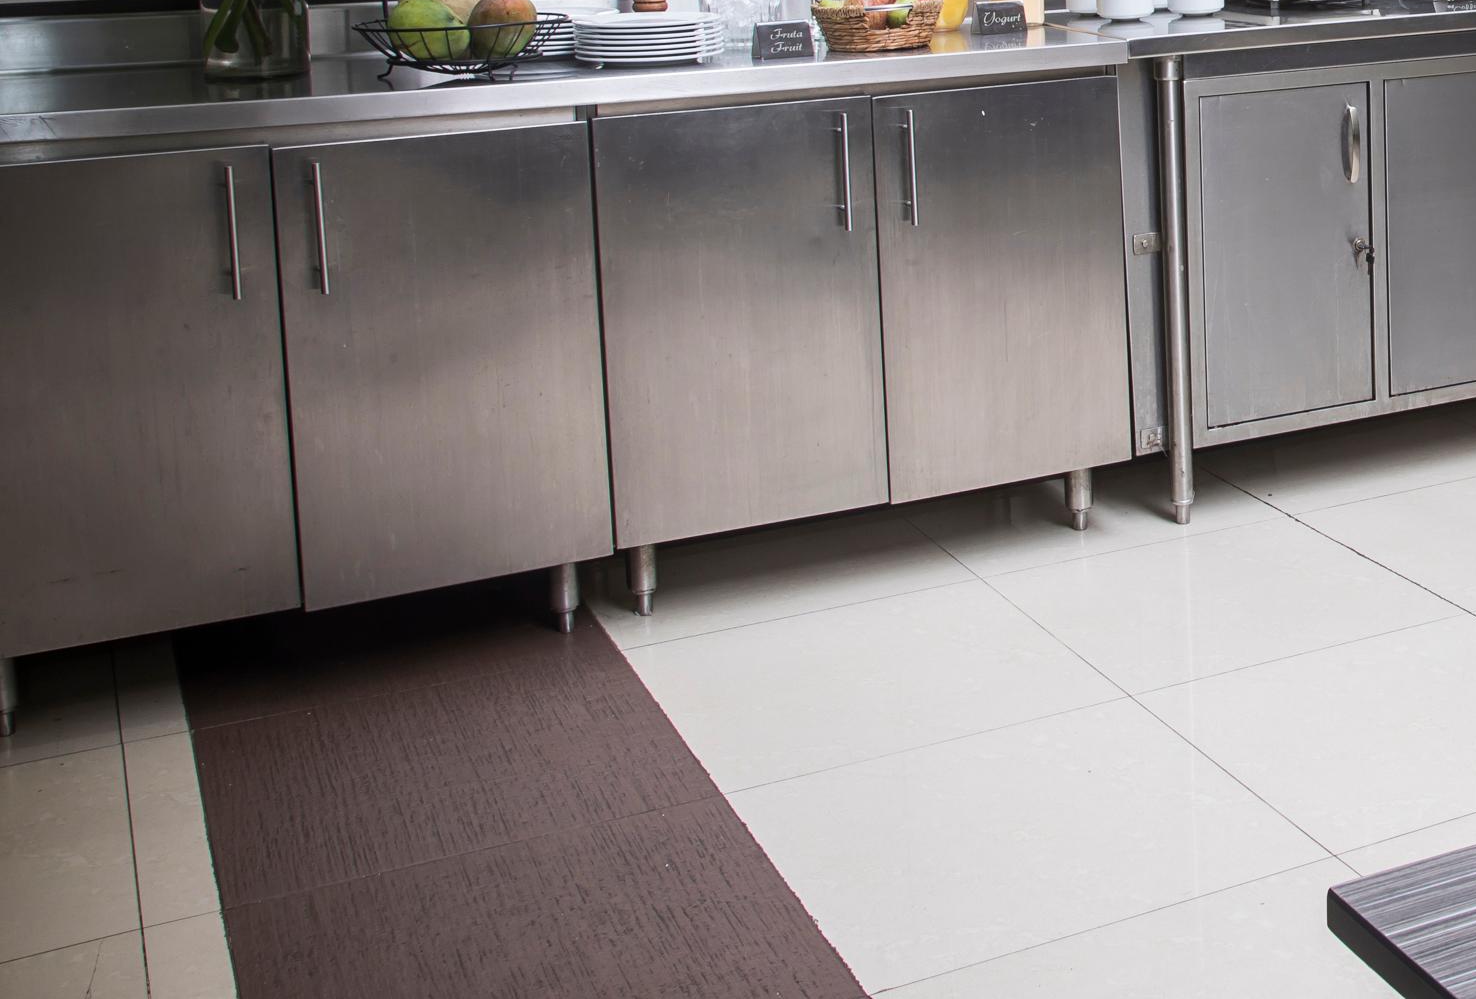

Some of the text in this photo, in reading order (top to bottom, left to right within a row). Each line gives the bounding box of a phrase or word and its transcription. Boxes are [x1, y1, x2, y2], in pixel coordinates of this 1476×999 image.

[983, 11, 1021, 26] Yogurt
[770, 28, 803, 40] Fruta
[771, 41, 803, 54] Fruit
